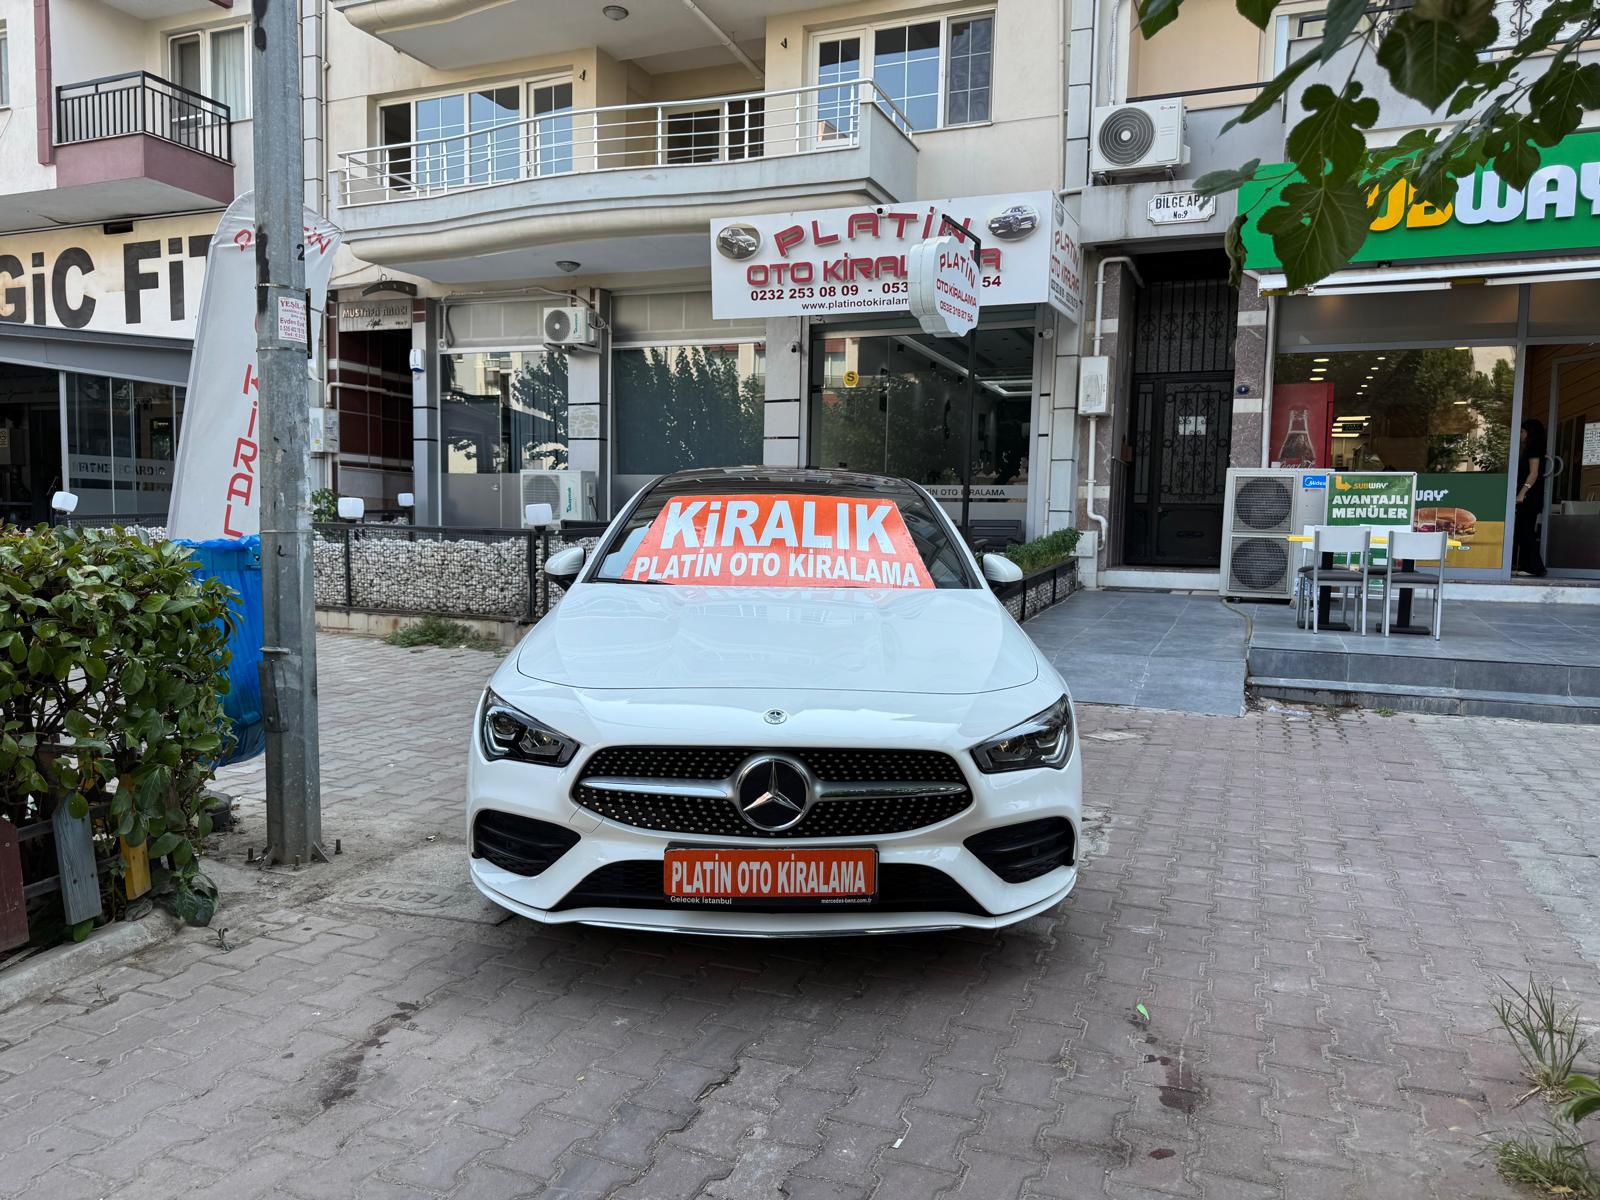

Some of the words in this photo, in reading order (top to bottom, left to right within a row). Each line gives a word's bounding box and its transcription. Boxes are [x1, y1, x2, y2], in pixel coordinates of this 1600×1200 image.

[1155, 195, 1185, 209] BİLGE
[774, 206, 971, 257] PLATİN
[746, 261, 814, 287] OTO
[939, 251, 976, 289] PLATİN
[750, 289, 785, 301] 0232
[789, 287, 814, 299] 253
[819, 286, 837, 298] 08
[841, 284, 859, 296] 09
[982, 275, 1002, 288] 54
[936, 278, 948, 294] OTO
[948, 283, 977, 309] KİRALAMA
[1332, 494, 1409, 505] AVANTAJLI
[1332, 505, 1408, 519] MENÜLER
[632, 548, 722, 581] PLATİN
[729, 552, 781, 578] OTO
[788, 548, 921, 587] KİRALAMA
[671, 853, 732, 894] PLATİN
[737, 860, 772, 894] OTO
[777, 853, 866, 893] KİRALAMA
[670, 896, 700, 904] Gelecek
